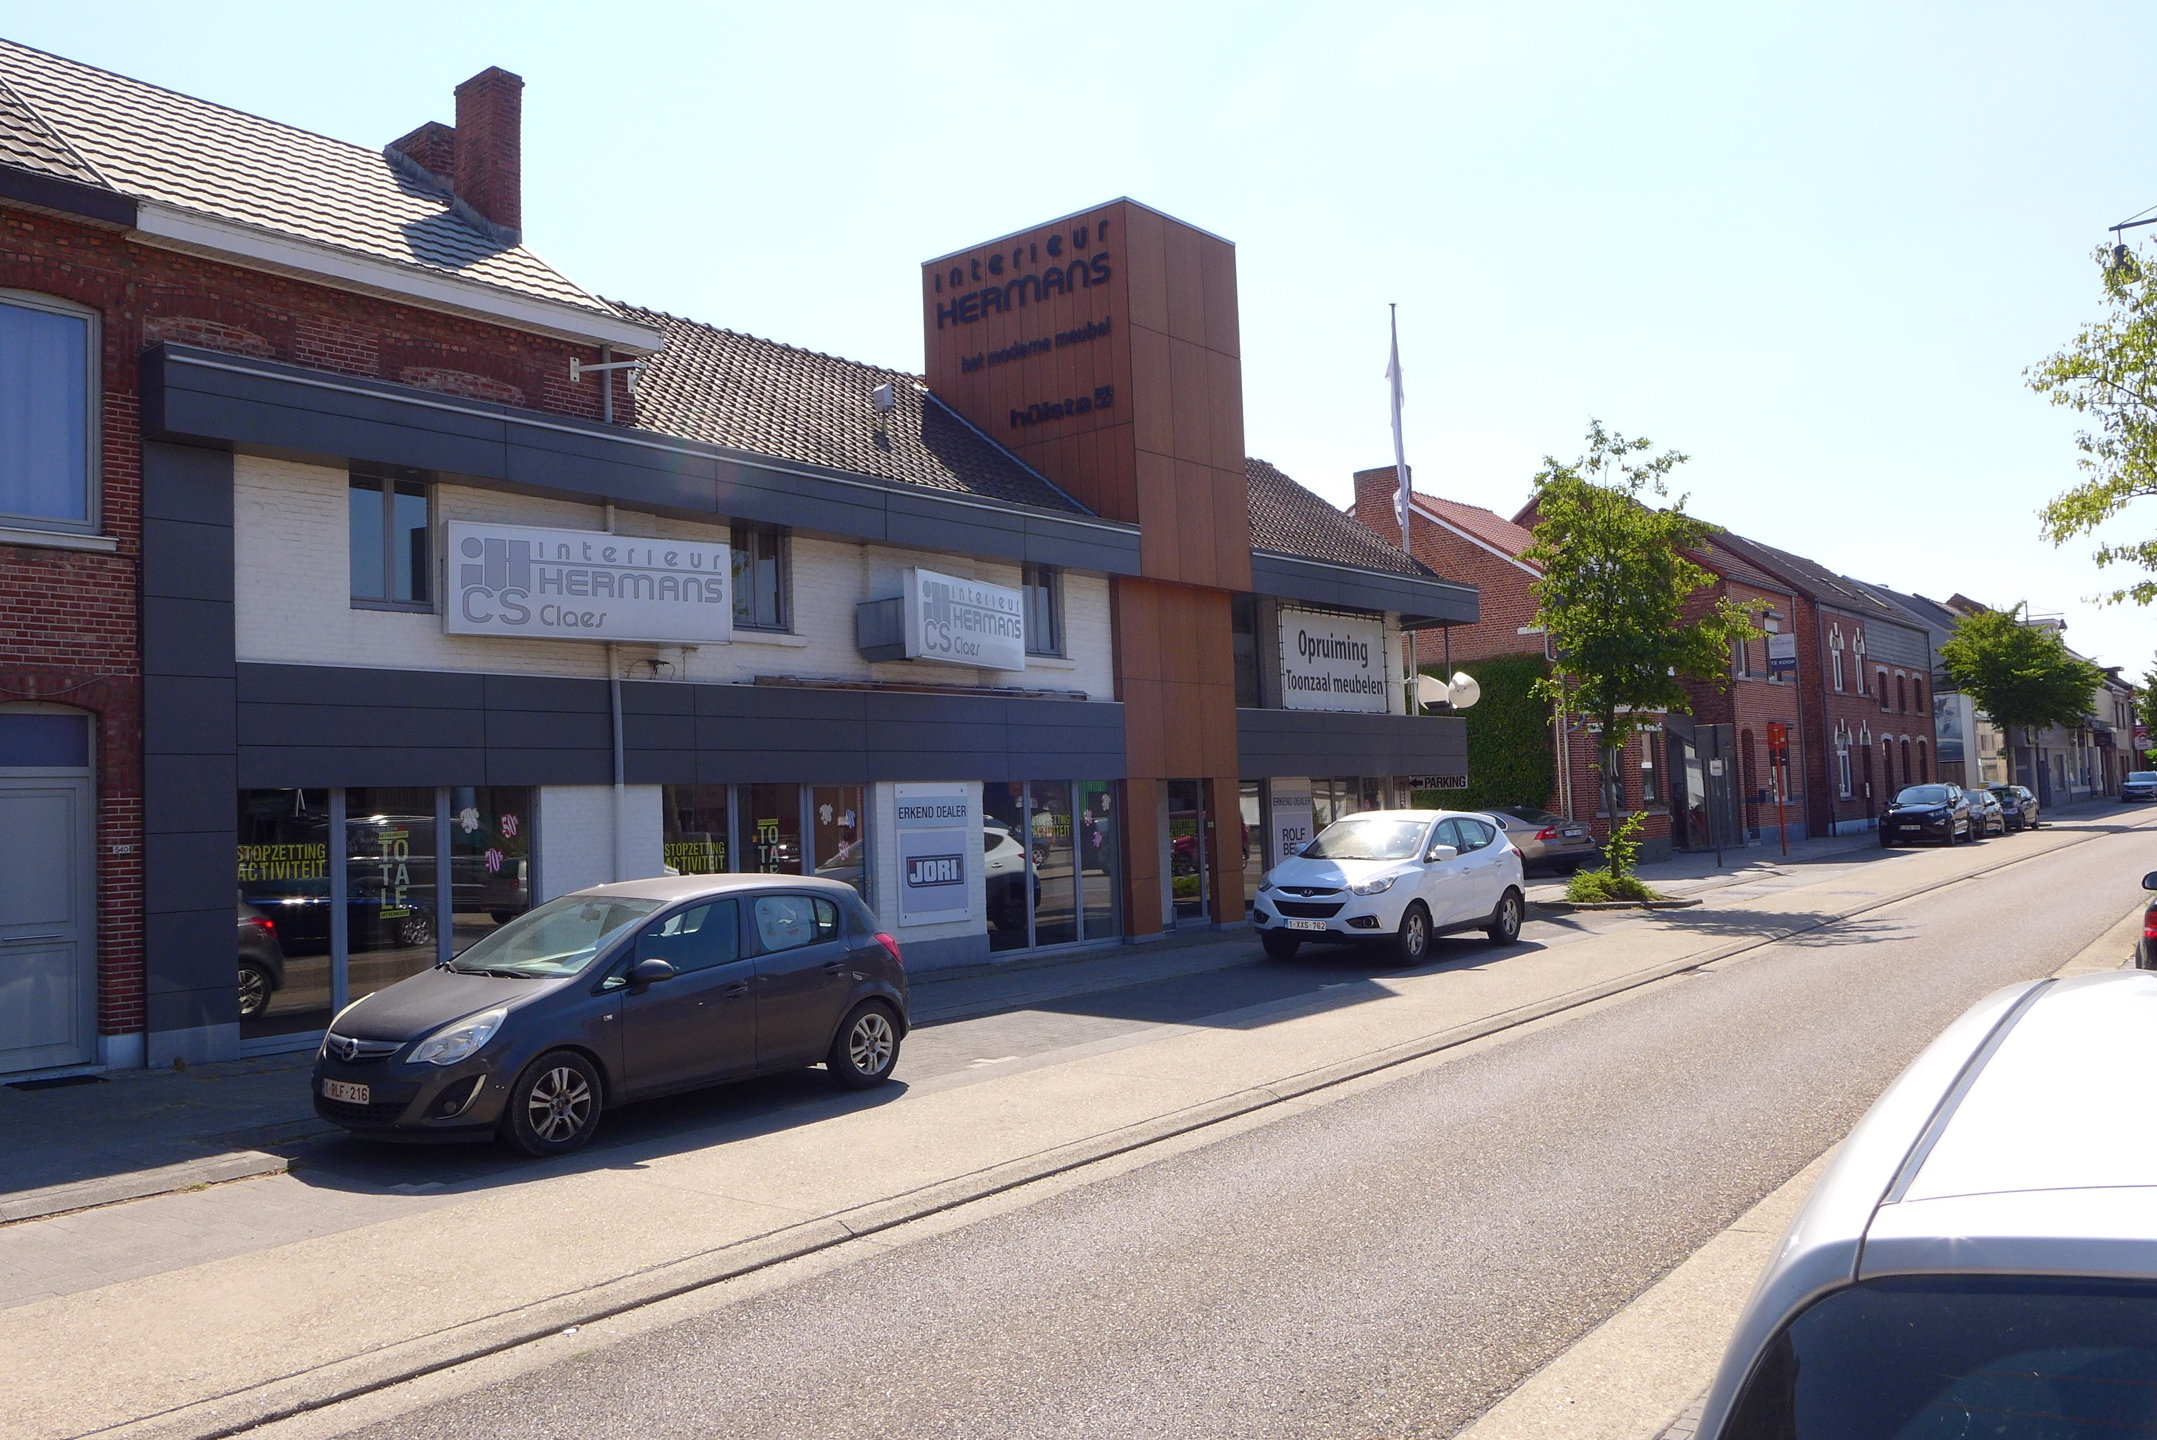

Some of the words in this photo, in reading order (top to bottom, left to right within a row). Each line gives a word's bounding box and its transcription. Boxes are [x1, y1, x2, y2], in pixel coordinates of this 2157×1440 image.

[934, 220, 1109, 293] interieur
[936, 251, 1111, 331] HERMANS
[961, 351, 984, 374] het
[987, 339, 1051, 366] moderne
[1055, 315, 1112, 347] meubel
[538, 541, 721, 570] interieur
[539, 567, 723, 604] HERMANS
[951, 585, 1021, 613] interieur
[461, 586, 531, 626] CS
[539, 604, 608, 629] Claes
[953, 606, 1022, 640] HERMANS
[924, 619, 952, 653] CS
[954, 636, 981, 657] Claes
[1298, 629, 1369, 669] Opruiming
[1286, 669, 1332, 693] Toonzaal
[1332, 673, 1384, 695] meubelen
[1424, 775, 1466, 788] PARKING
[898, 806, 934, 819] ERKEND
[936, 804, 967, 818] DEALER
[1272, 796, 1293, 807] ERKEND
[1293, 795, 1311, 806] DEALER
[1282, 828, 1306, 842] ROLF
[237, 843, 327, 862] STOPZETTING
[664, 842, 725, 857] STOPZETTING
[237, 859, 328, 882] ACTIVITEIT
[665, 855, 725, 872] ACTIVITEIT
[909, 859, 957, 883] JORI
